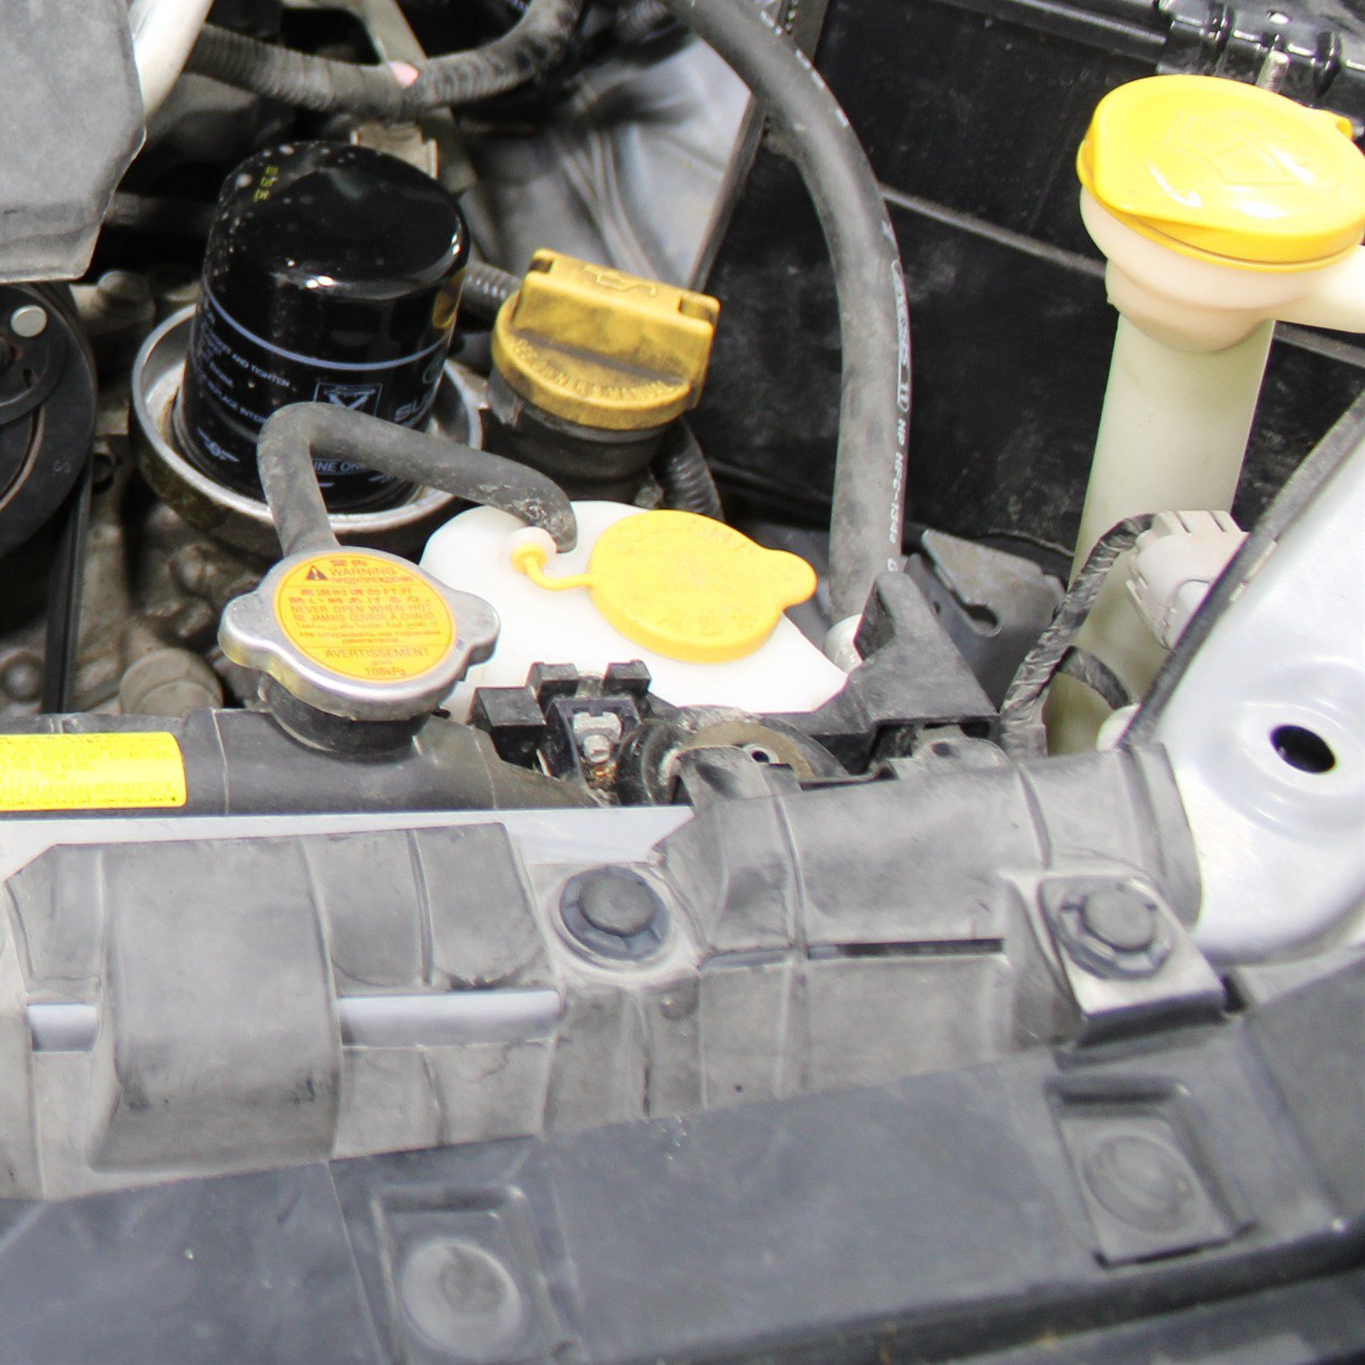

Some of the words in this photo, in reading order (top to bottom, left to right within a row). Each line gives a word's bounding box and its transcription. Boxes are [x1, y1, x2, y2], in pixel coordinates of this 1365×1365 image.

[330, 567, 396, 576] WARNING
[292, 604, 329, 614] NEVER
[334, 605, 364, 613] OPEN
[368, 604, 405, 613] WHEN
[409, 603, 432, 613] HOT
[313, 613, 347, 622] JAMAIS
[401, 612, 435, 621] CHAUD
[325, 647, 430, 659] AVERTISSEMENT
